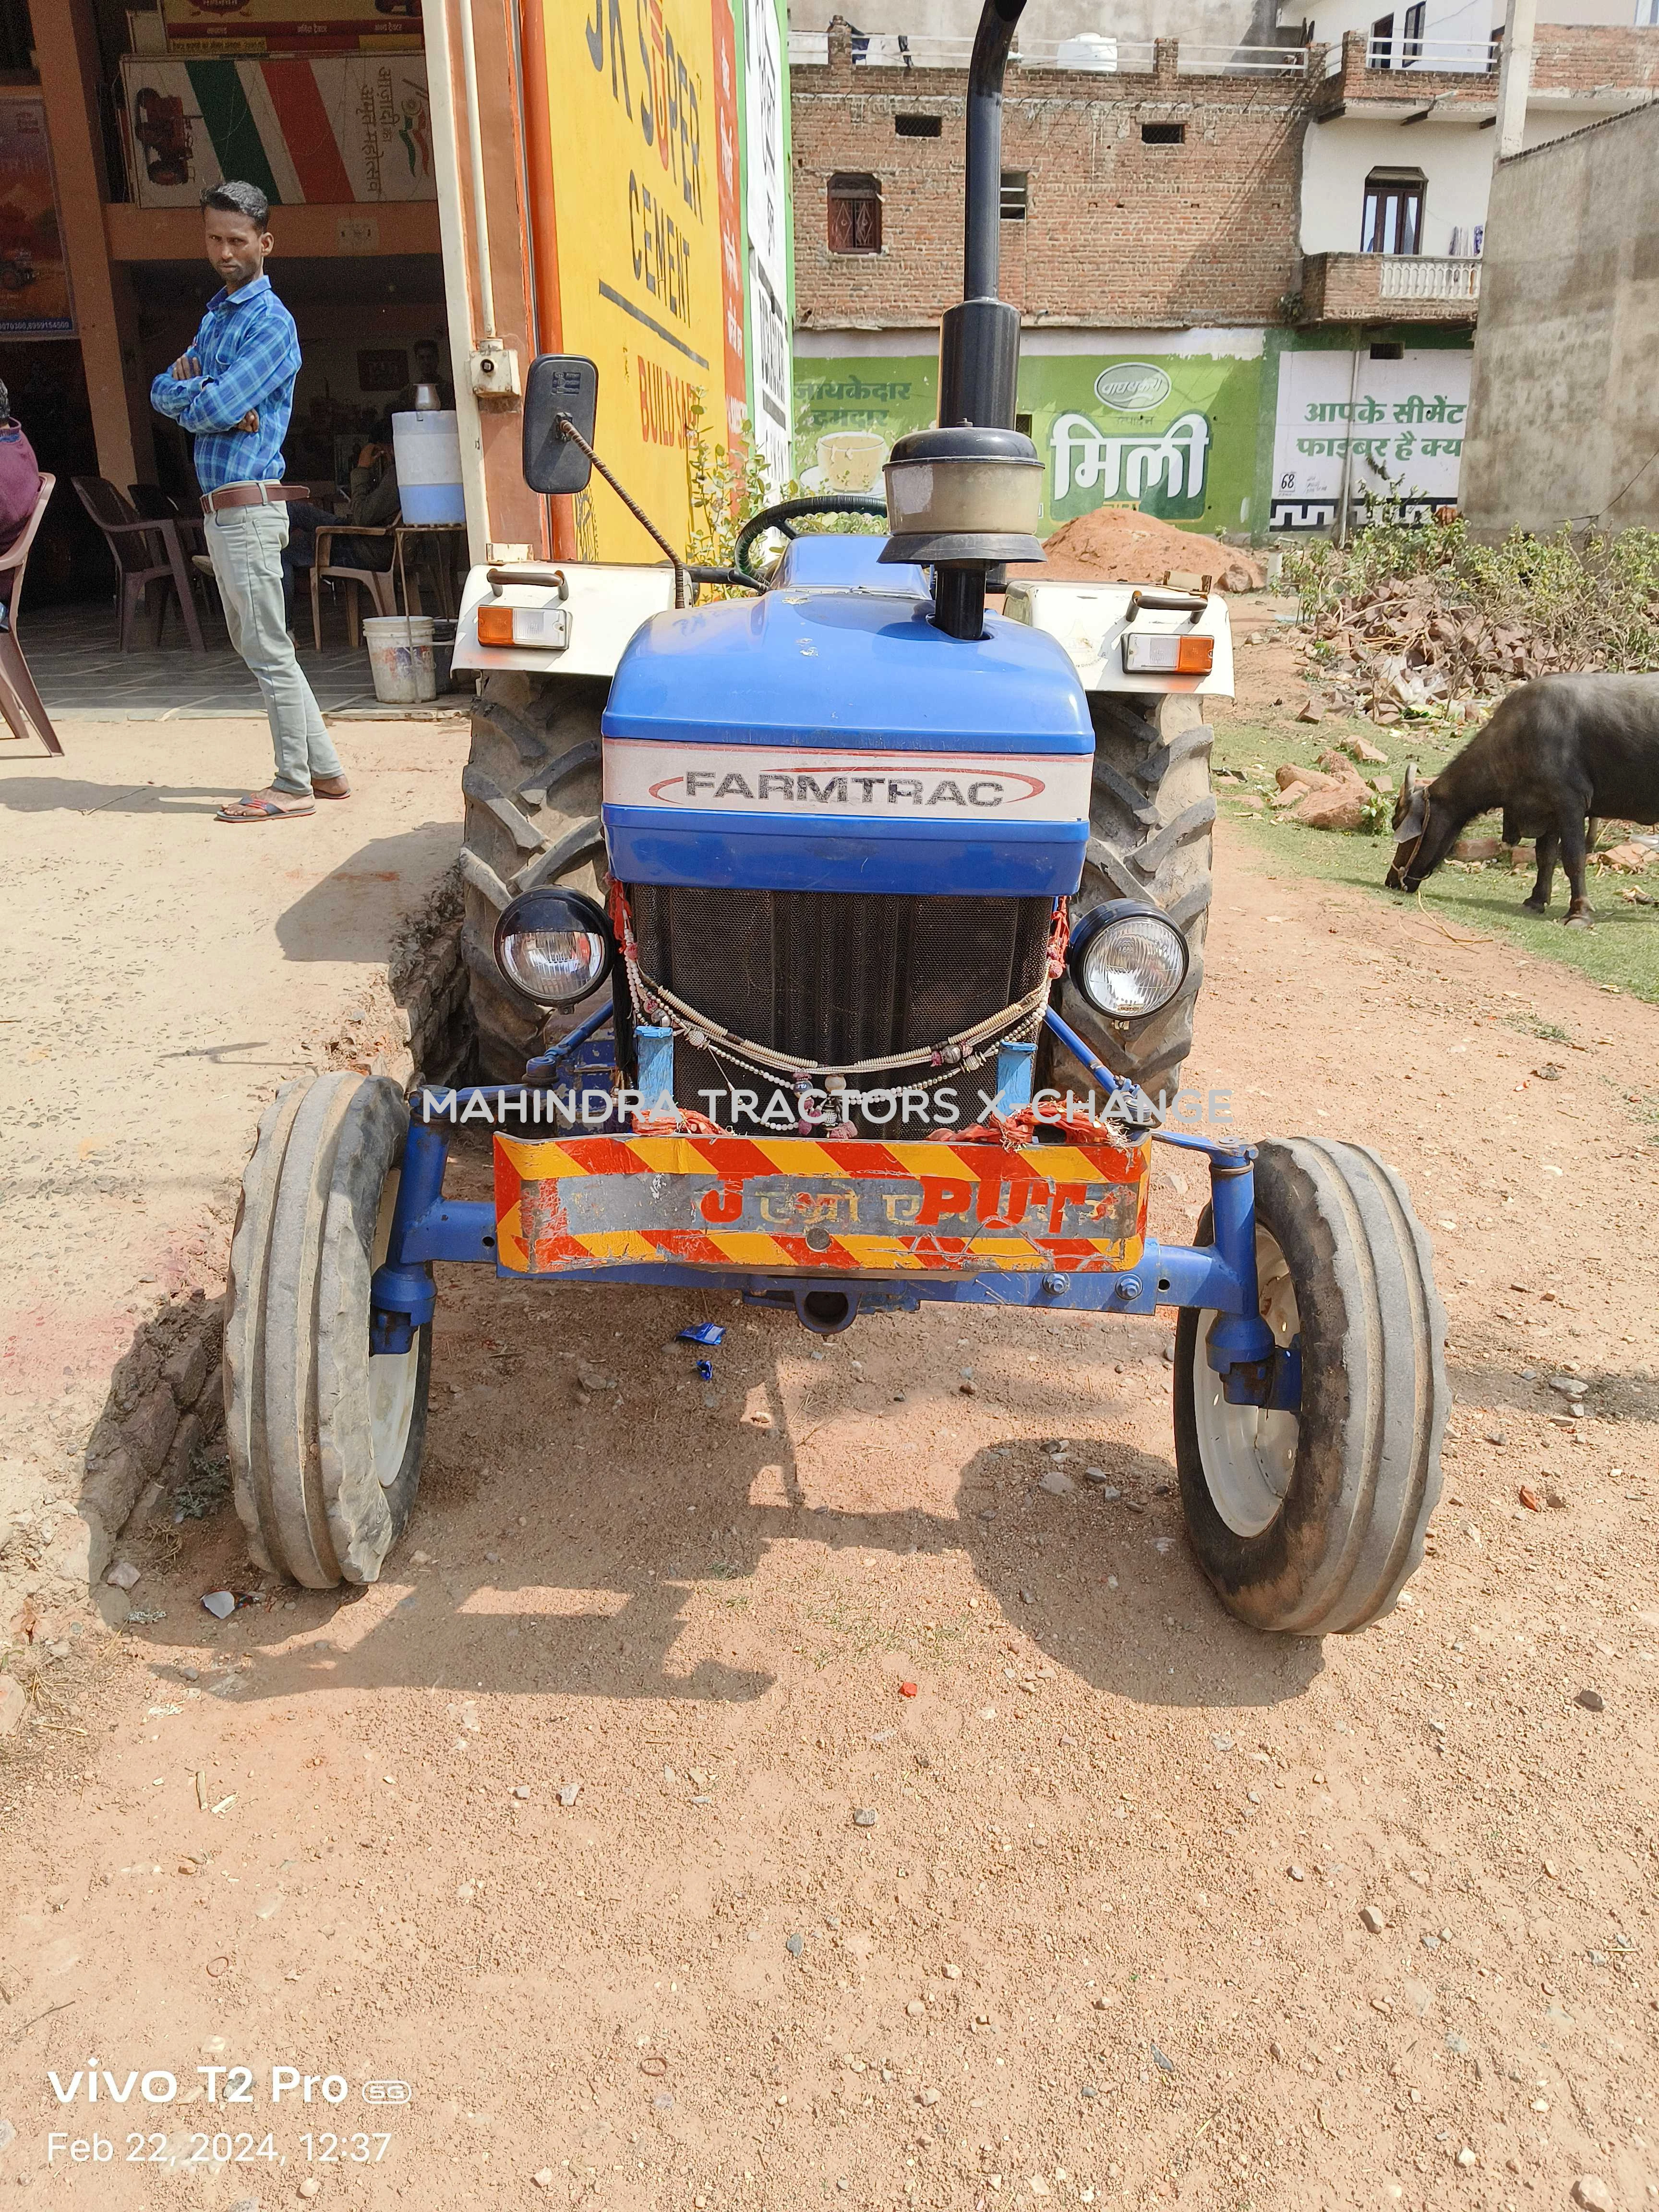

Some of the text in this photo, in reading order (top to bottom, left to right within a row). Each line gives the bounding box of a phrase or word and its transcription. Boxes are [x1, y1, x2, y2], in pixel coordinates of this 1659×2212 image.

[637, 0, 703, 225] SUPER
[629, 169, 690, 329] CEMENT
[637, 355, 674, 447] BUILD
[1304, 395, 1467, 424] आपके सीमेंट
[1050, 413, 1209, 500] मिली
[1393, 431, 1417, 461] है
[1421, 438, 1463, 457] क्य
[1281, 474, 1295, 489] 68
[685, 770, 1004, 807] FARMTRAC
